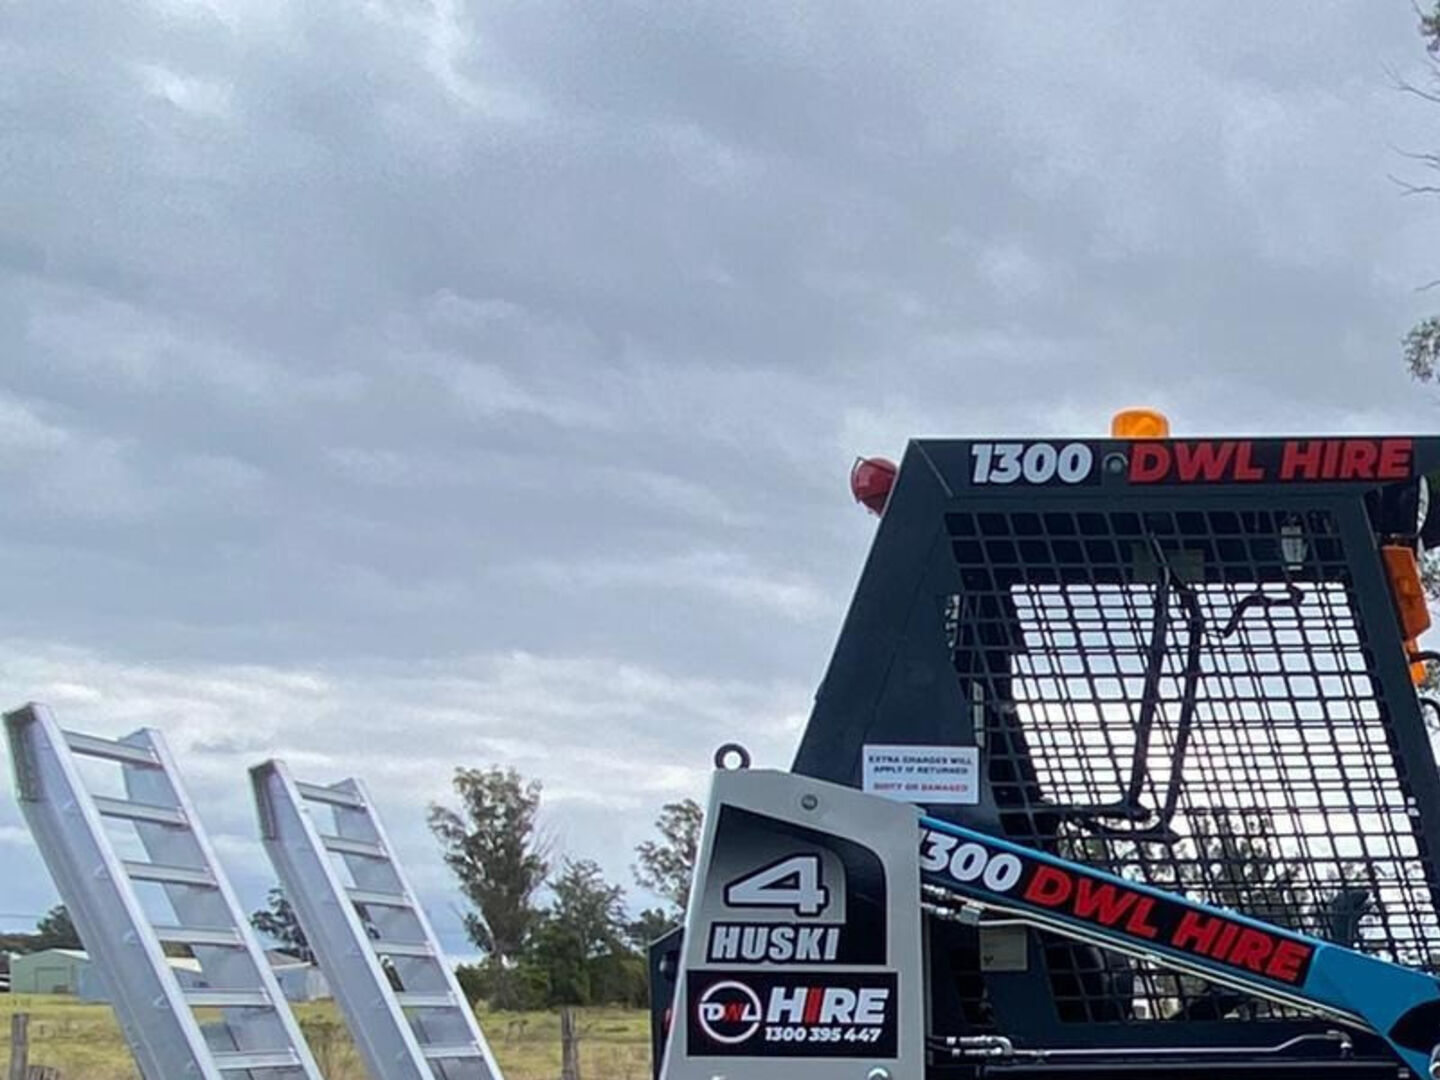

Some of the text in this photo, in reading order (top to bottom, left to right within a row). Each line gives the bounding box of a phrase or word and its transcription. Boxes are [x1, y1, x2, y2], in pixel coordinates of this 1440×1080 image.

[970, 439, 1413, 484] 1300 DWL HIRE
[868, 755, 972, 765] EXTRA CHARGES WILL
[873, 765, 903, 774] APPLY
[917, 766, 968, 775] RETURNED
[873, 782, 902, 791] DIRTY
[921, 783, 968, 792] DAMAGED
[727, 855, 826, 915] 4
[920, 828, 1310, 983] 300 DWL HIRE
[710, 925, 840, 961] HUSKI
[766, 986, 890, 1025] HIRE
[764, 1026, 882, 1043] 1300 395 447
